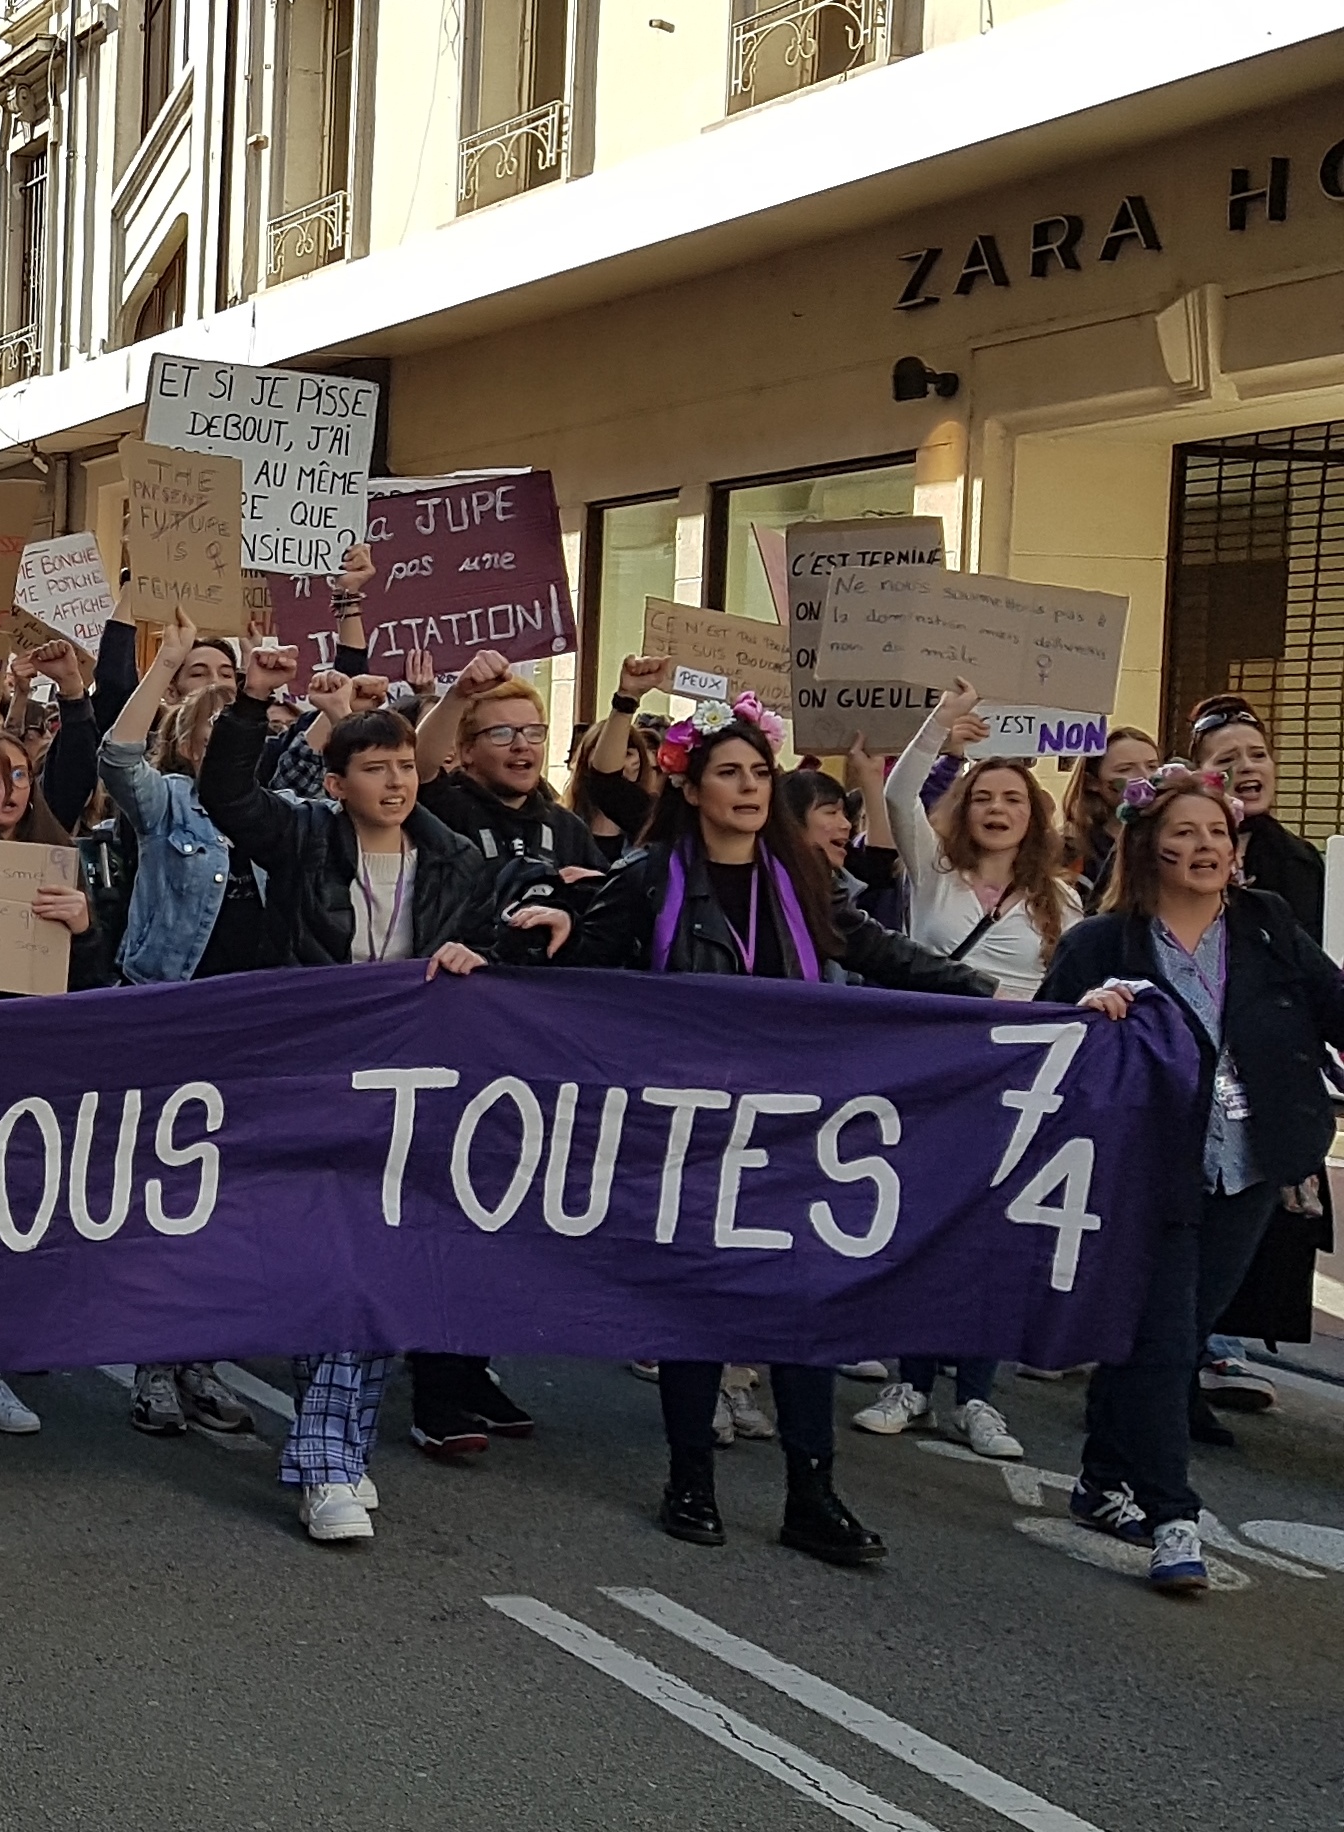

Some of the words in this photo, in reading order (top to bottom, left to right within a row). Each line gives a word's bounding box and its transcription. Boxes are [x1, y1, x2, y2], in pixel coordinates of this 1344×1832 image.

[893, 196, 1162, 312] ZARA
[159, 363, 200, 398] ET
[250, 376, 289, 409] JE
[185, 411, 294, 453] DEBOUT,
[147, 458, 217, 492] THE
[254, 460, 288, 488] AU
[297, 460, 364, 496] MÊME
[290, 501, 339, 529] QUE
[415, 485, 516, 536] JUPE
[166, 540, 189, 563] IS
[792, 551, 850, 577] C'EST
[385, 554, 435, 594] pas
[458, 551, 517, 577] une
[137, 576, 224, 605] FEMALE
[834, 574, 869, 595] Ne
[880, 579, 931, 594] nous
[1054, 610, 1085, 624] pas
[52, 594, 112, 622] AFFICHE
[796, 601, 822, 621] ON
[834, 607, 848, 624] la
[651, 612, 677, 635] CE
[685, 621, 729, 639] N'EST
[655, 639, 679, 655] JE
[692, 643, 727, 662] SUIS
[679, 671, 723, 691] PEUX
[799, 688, 826, 709] ON
[836, 687, 940, 710] GUEULE
[1037, 714, 1108, 753] NON
[351, 1066, 902, 1259] TOUTES
[990, 1021, 1088, 1188] 7
[1006, 1136, 1102, 1291] 4
